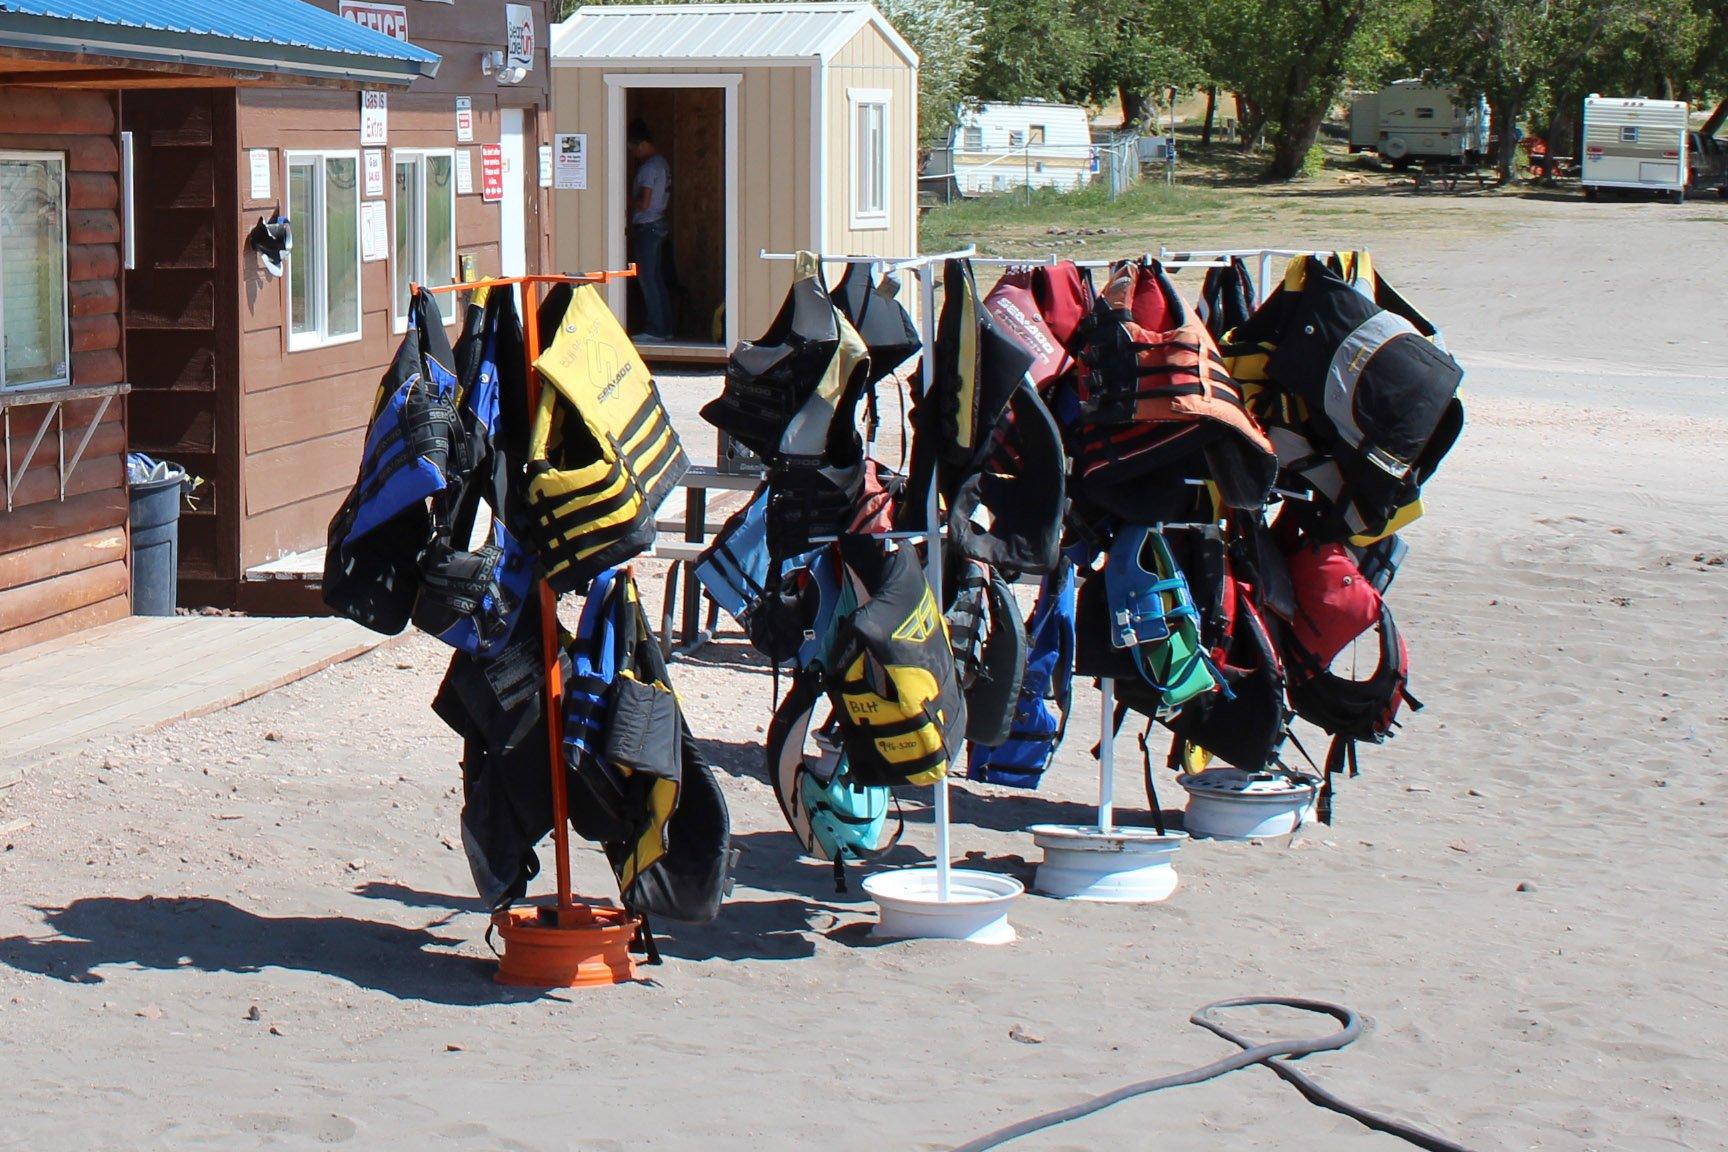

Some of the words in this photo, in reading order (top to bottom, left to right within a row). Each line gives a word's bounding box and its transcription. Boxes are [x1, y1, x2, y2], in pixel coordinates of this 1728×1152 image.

[365, 91, 378, 109] Gas
[367, 117, 383, 138] Extra
[848, 701, 878, 714] BLH
